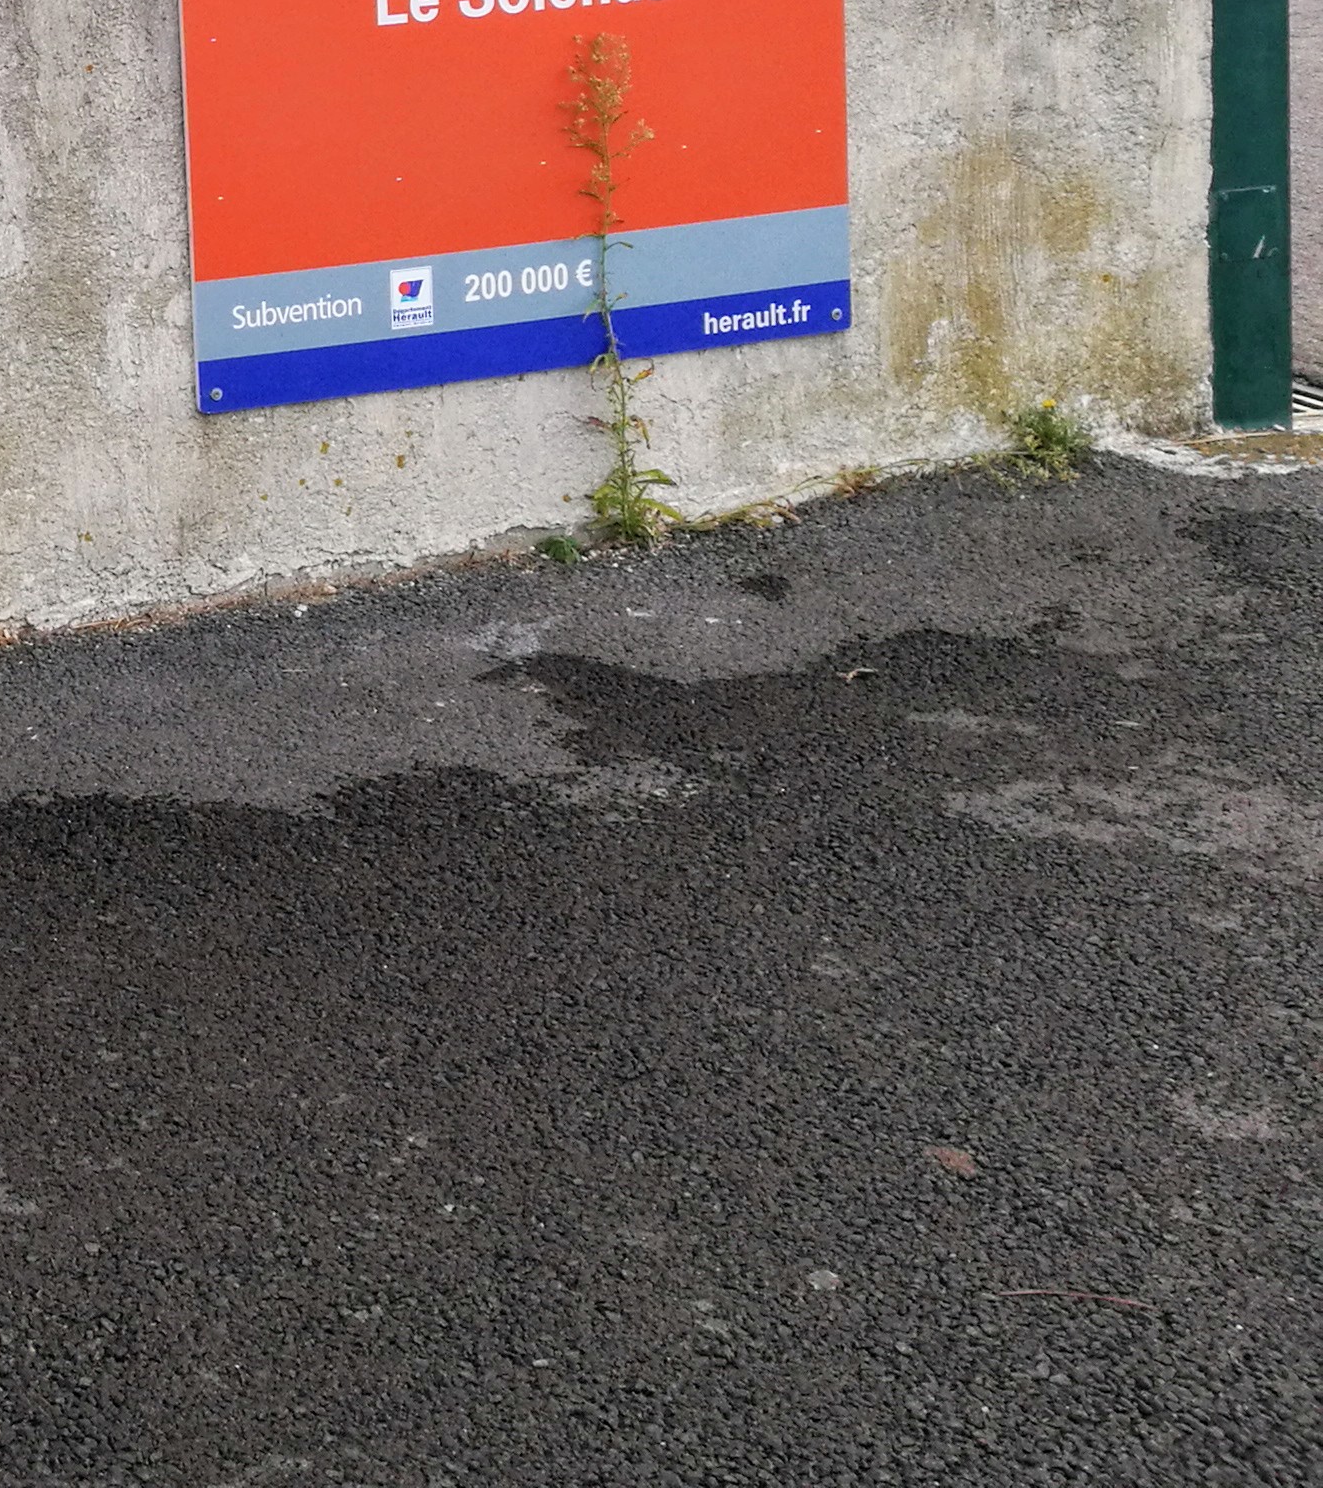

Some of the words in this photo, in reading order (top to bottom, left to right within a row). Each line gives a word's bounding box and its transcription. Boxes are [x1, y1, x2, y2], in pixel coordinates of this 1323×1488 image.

[232, 293, 362, 329] Subvention
[465, 269, 512, 303] 200
[522, 264, 569, 297] 000
[576, 258, 594, 288] €
[704, 299, 811, 336] herault.fr
